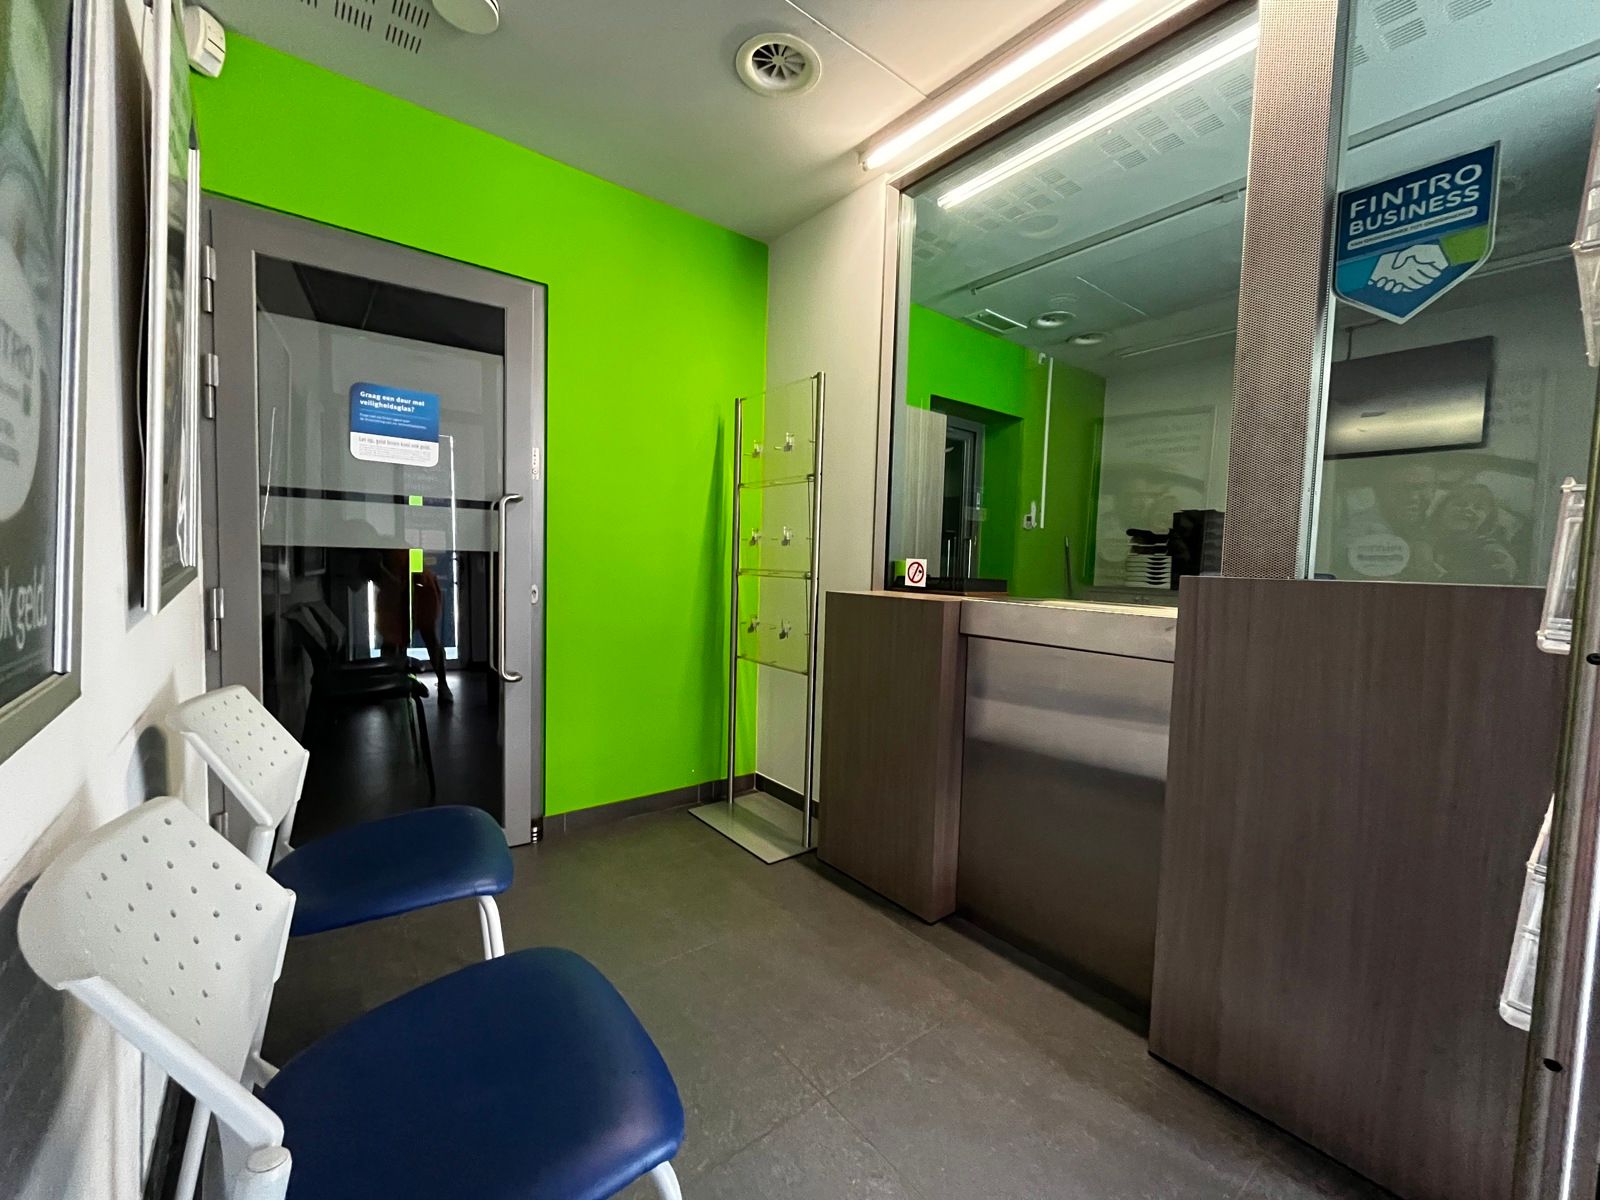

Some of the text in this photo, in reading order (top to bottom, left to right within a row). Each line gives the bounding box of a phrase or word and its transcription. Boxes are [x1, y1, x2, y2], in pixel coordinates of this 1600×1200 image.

[1349, 185, 1480, 236] BUSINESS
[1350, 164, 1482, 219] FINTRO
[360, 390, 381, 401] Graag
[396, 396, 411, 404] deur
[360, 400, 415, 412] veiligheidsglas?
[16, 565, 48, 650] geld.
